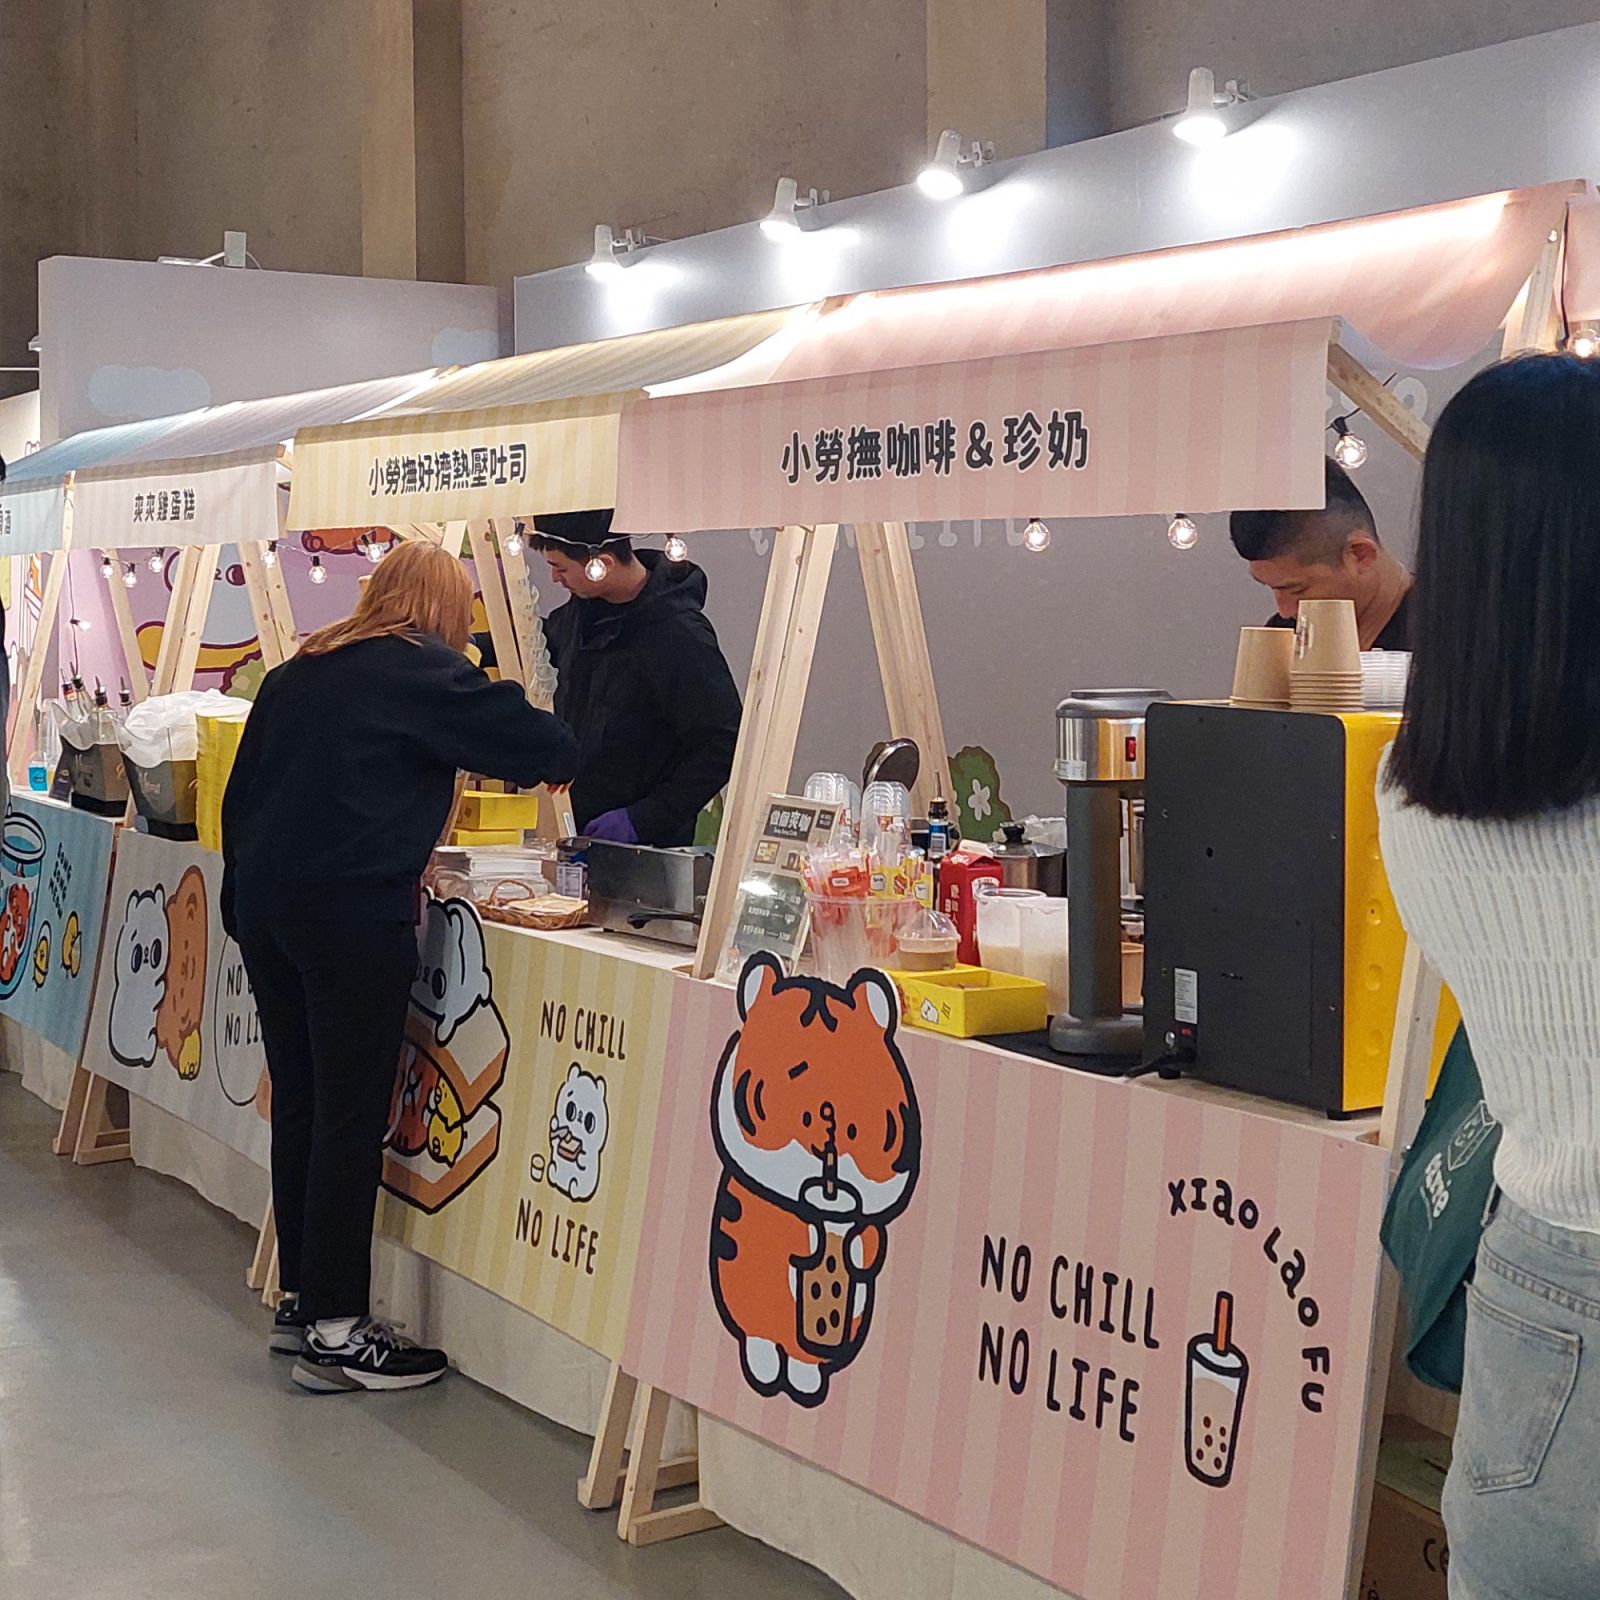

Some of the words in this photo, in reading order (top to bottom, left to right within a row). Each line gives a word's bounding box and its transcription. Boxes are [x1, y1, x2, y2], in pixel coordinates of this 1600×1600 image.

[225, 964, 243, 998] NO
[224, 1012, 241, 1048] NO
[541, 1001, 567, 1044] NO
[574, 1007, 626, 1061] CHILL
[515, 1197, 544, 1248] NO
[551, 1214, 599, 1275] LIFE
[980, 1234, 1032, 1303] NO
[1049, 1255, 1160, 1350] CHILL
[978, 1320, 1030, 1396] NO
[1046, 1348, 1140, 1443] LIFE
